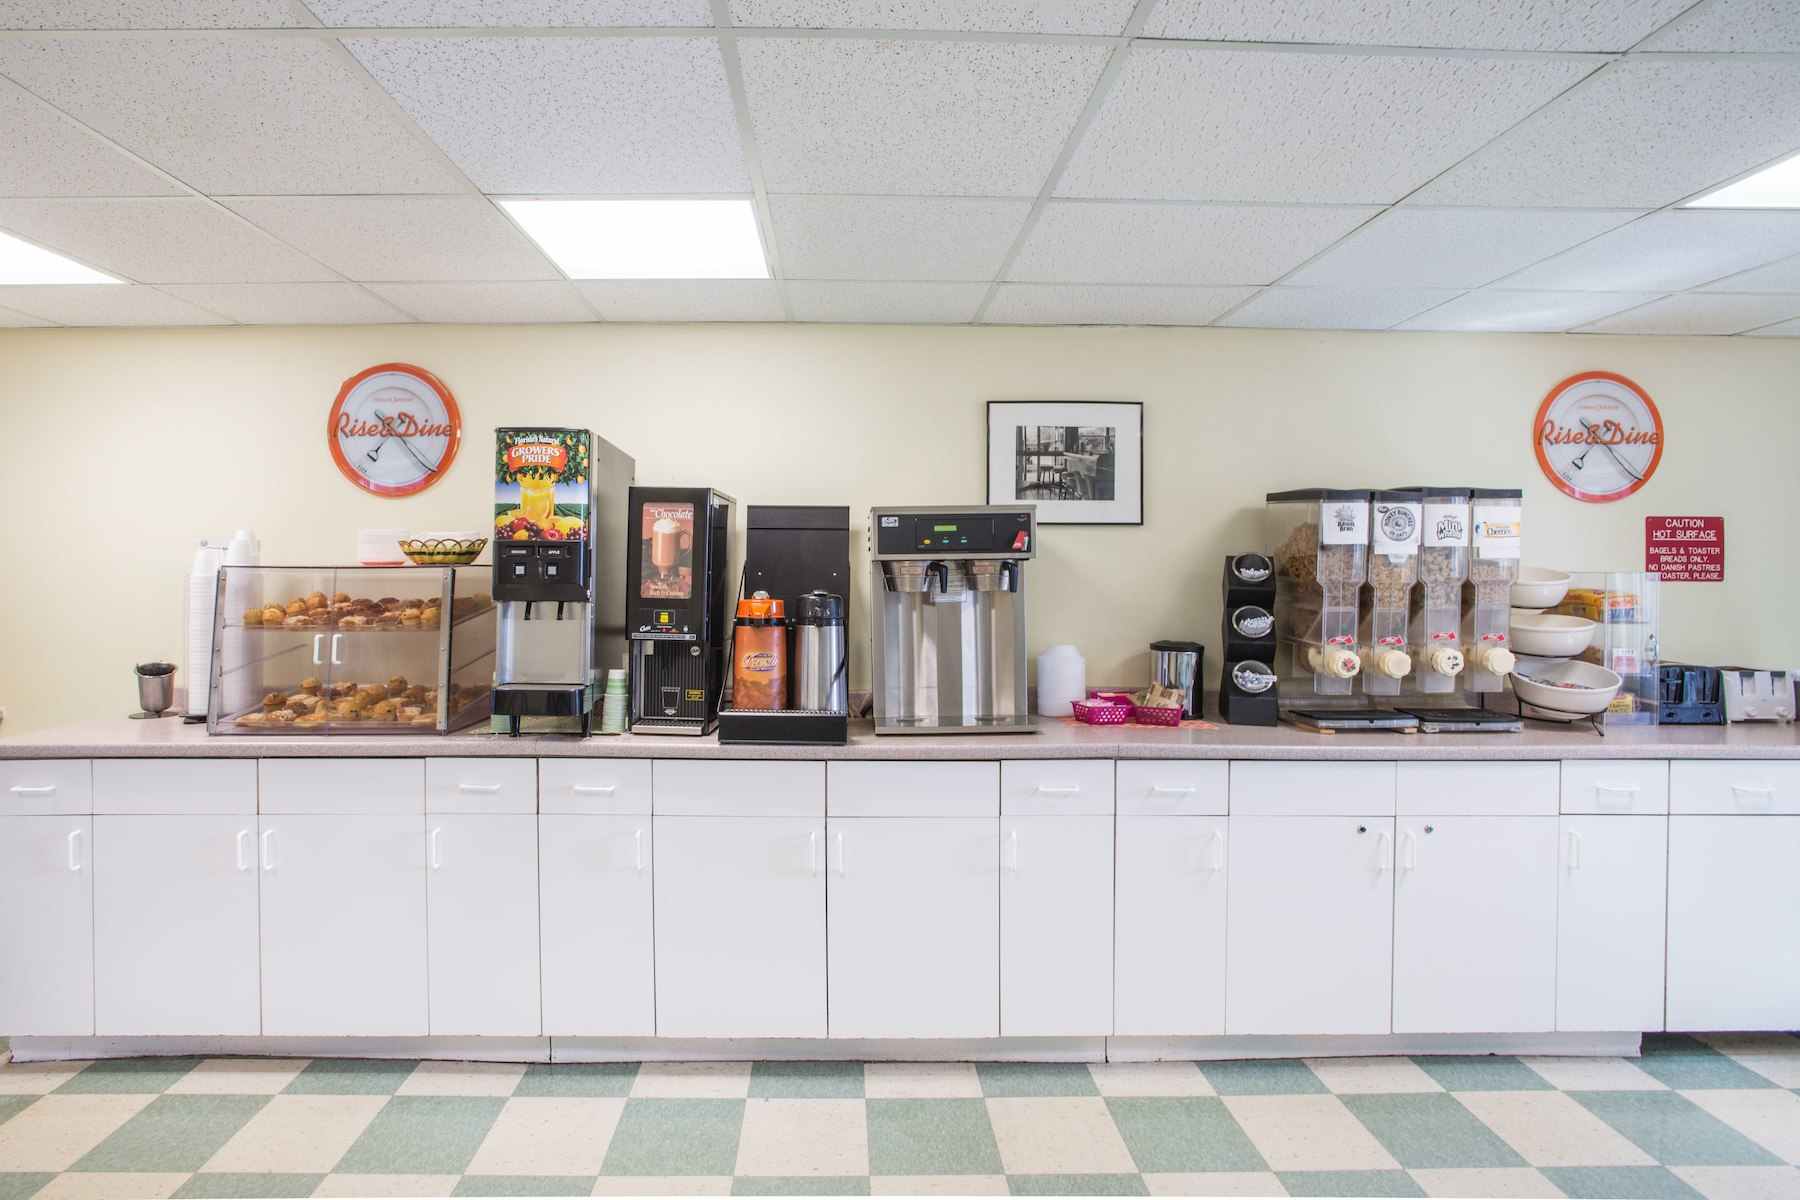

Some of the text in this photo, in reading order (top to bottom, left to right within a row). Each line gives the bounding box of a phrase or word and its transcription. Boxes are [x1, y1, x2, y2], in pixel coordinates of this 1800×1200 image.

[334, 412, 379, 438] Rise
[396, 411, 453, 437] Dine
[1538, 419, 1584, 446] Rise
[1601, 419, 1661, 445] Dine
[511, 446, 561, 457] GROWERS
[522, 455, 552, 463] PRIDE
[1665, 518, 1704, 528] CAUTION
[1653, 530, 1716, 539] HOT SURFACE
[1688, 547, 1720, 555] TOASTER
